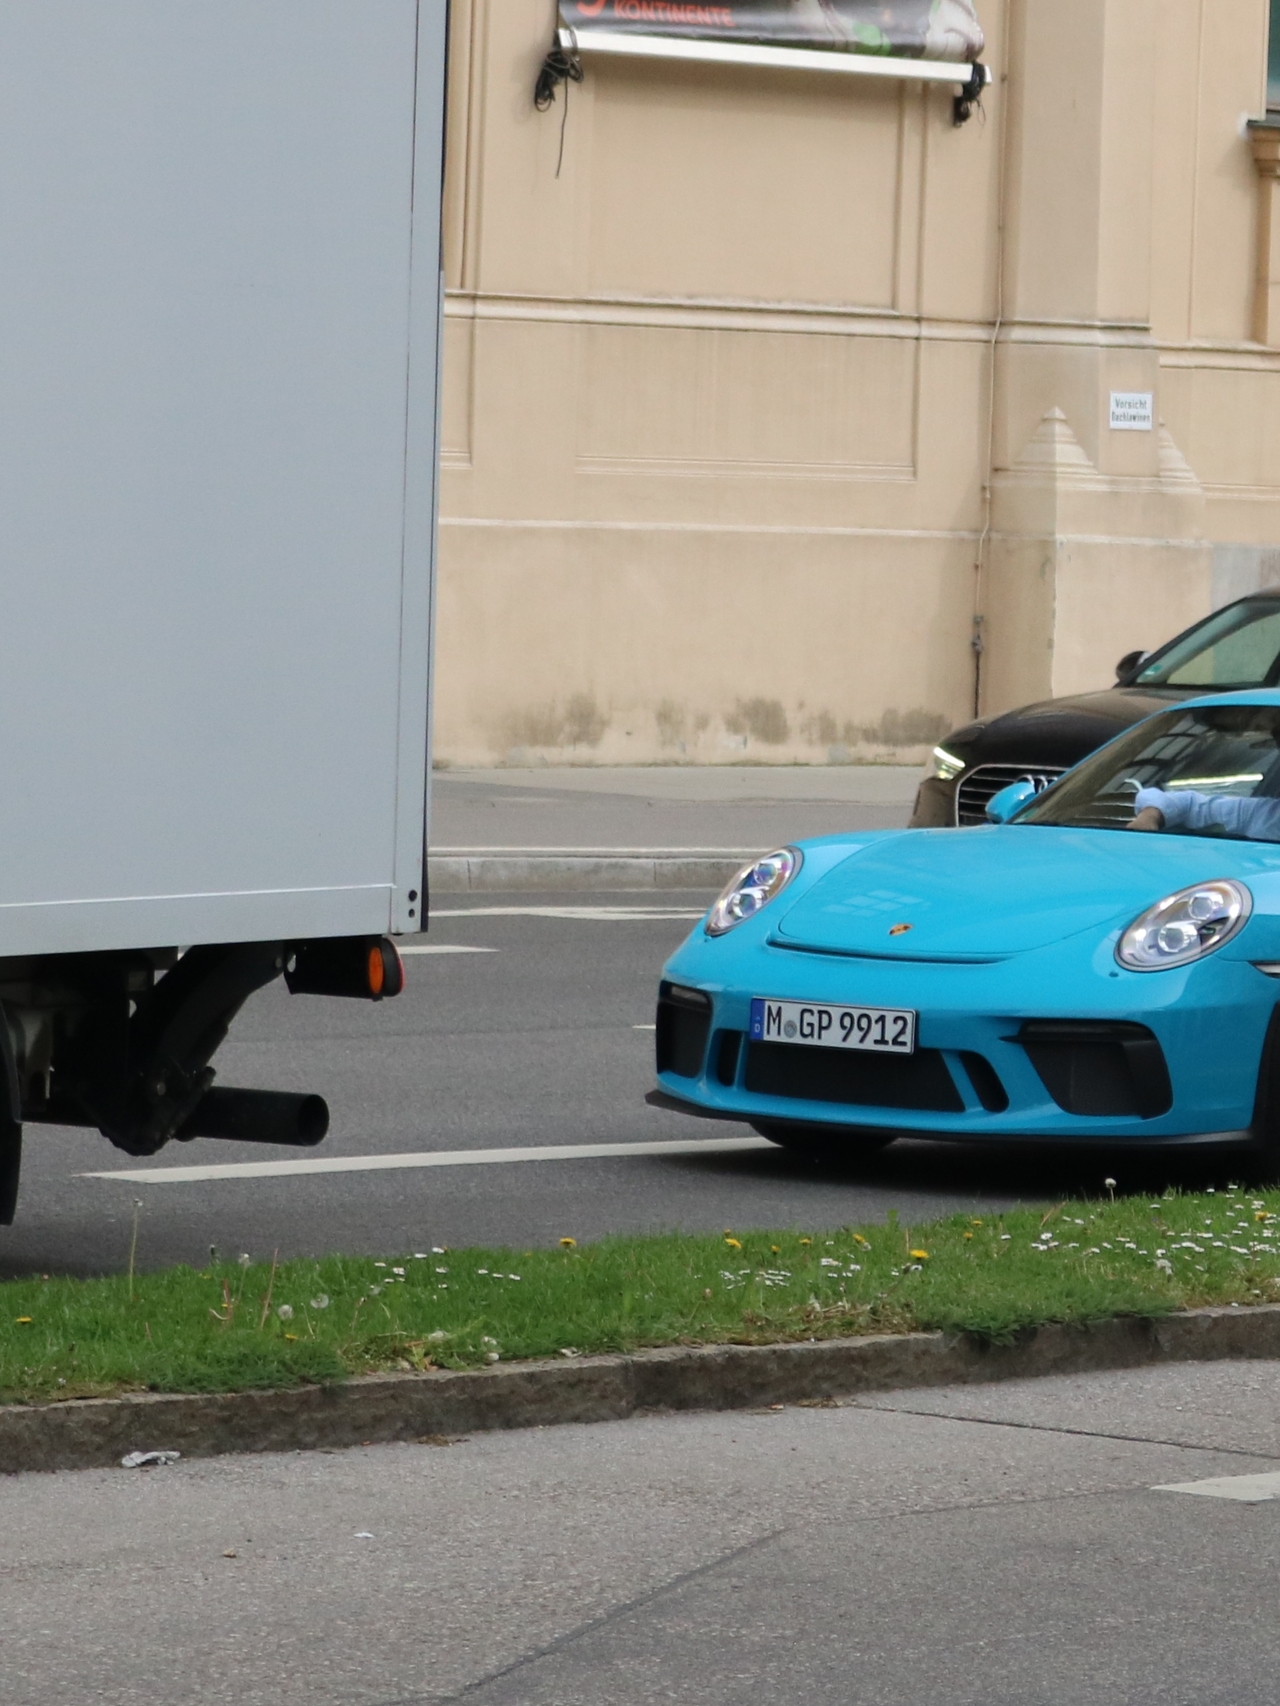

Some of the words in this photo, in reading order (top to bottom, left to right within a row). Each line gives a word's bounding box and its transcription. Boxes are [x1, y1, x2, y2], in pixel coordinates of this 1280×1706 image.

[614, 0, 736, 27] KONTINENTE
[1115, 398, 1147, 410] Vorsicht
[767, 1005, 782, 1036] M
[800, 1008, 832, 1040] GP
[840, 1012, 908, 1047] 9912
